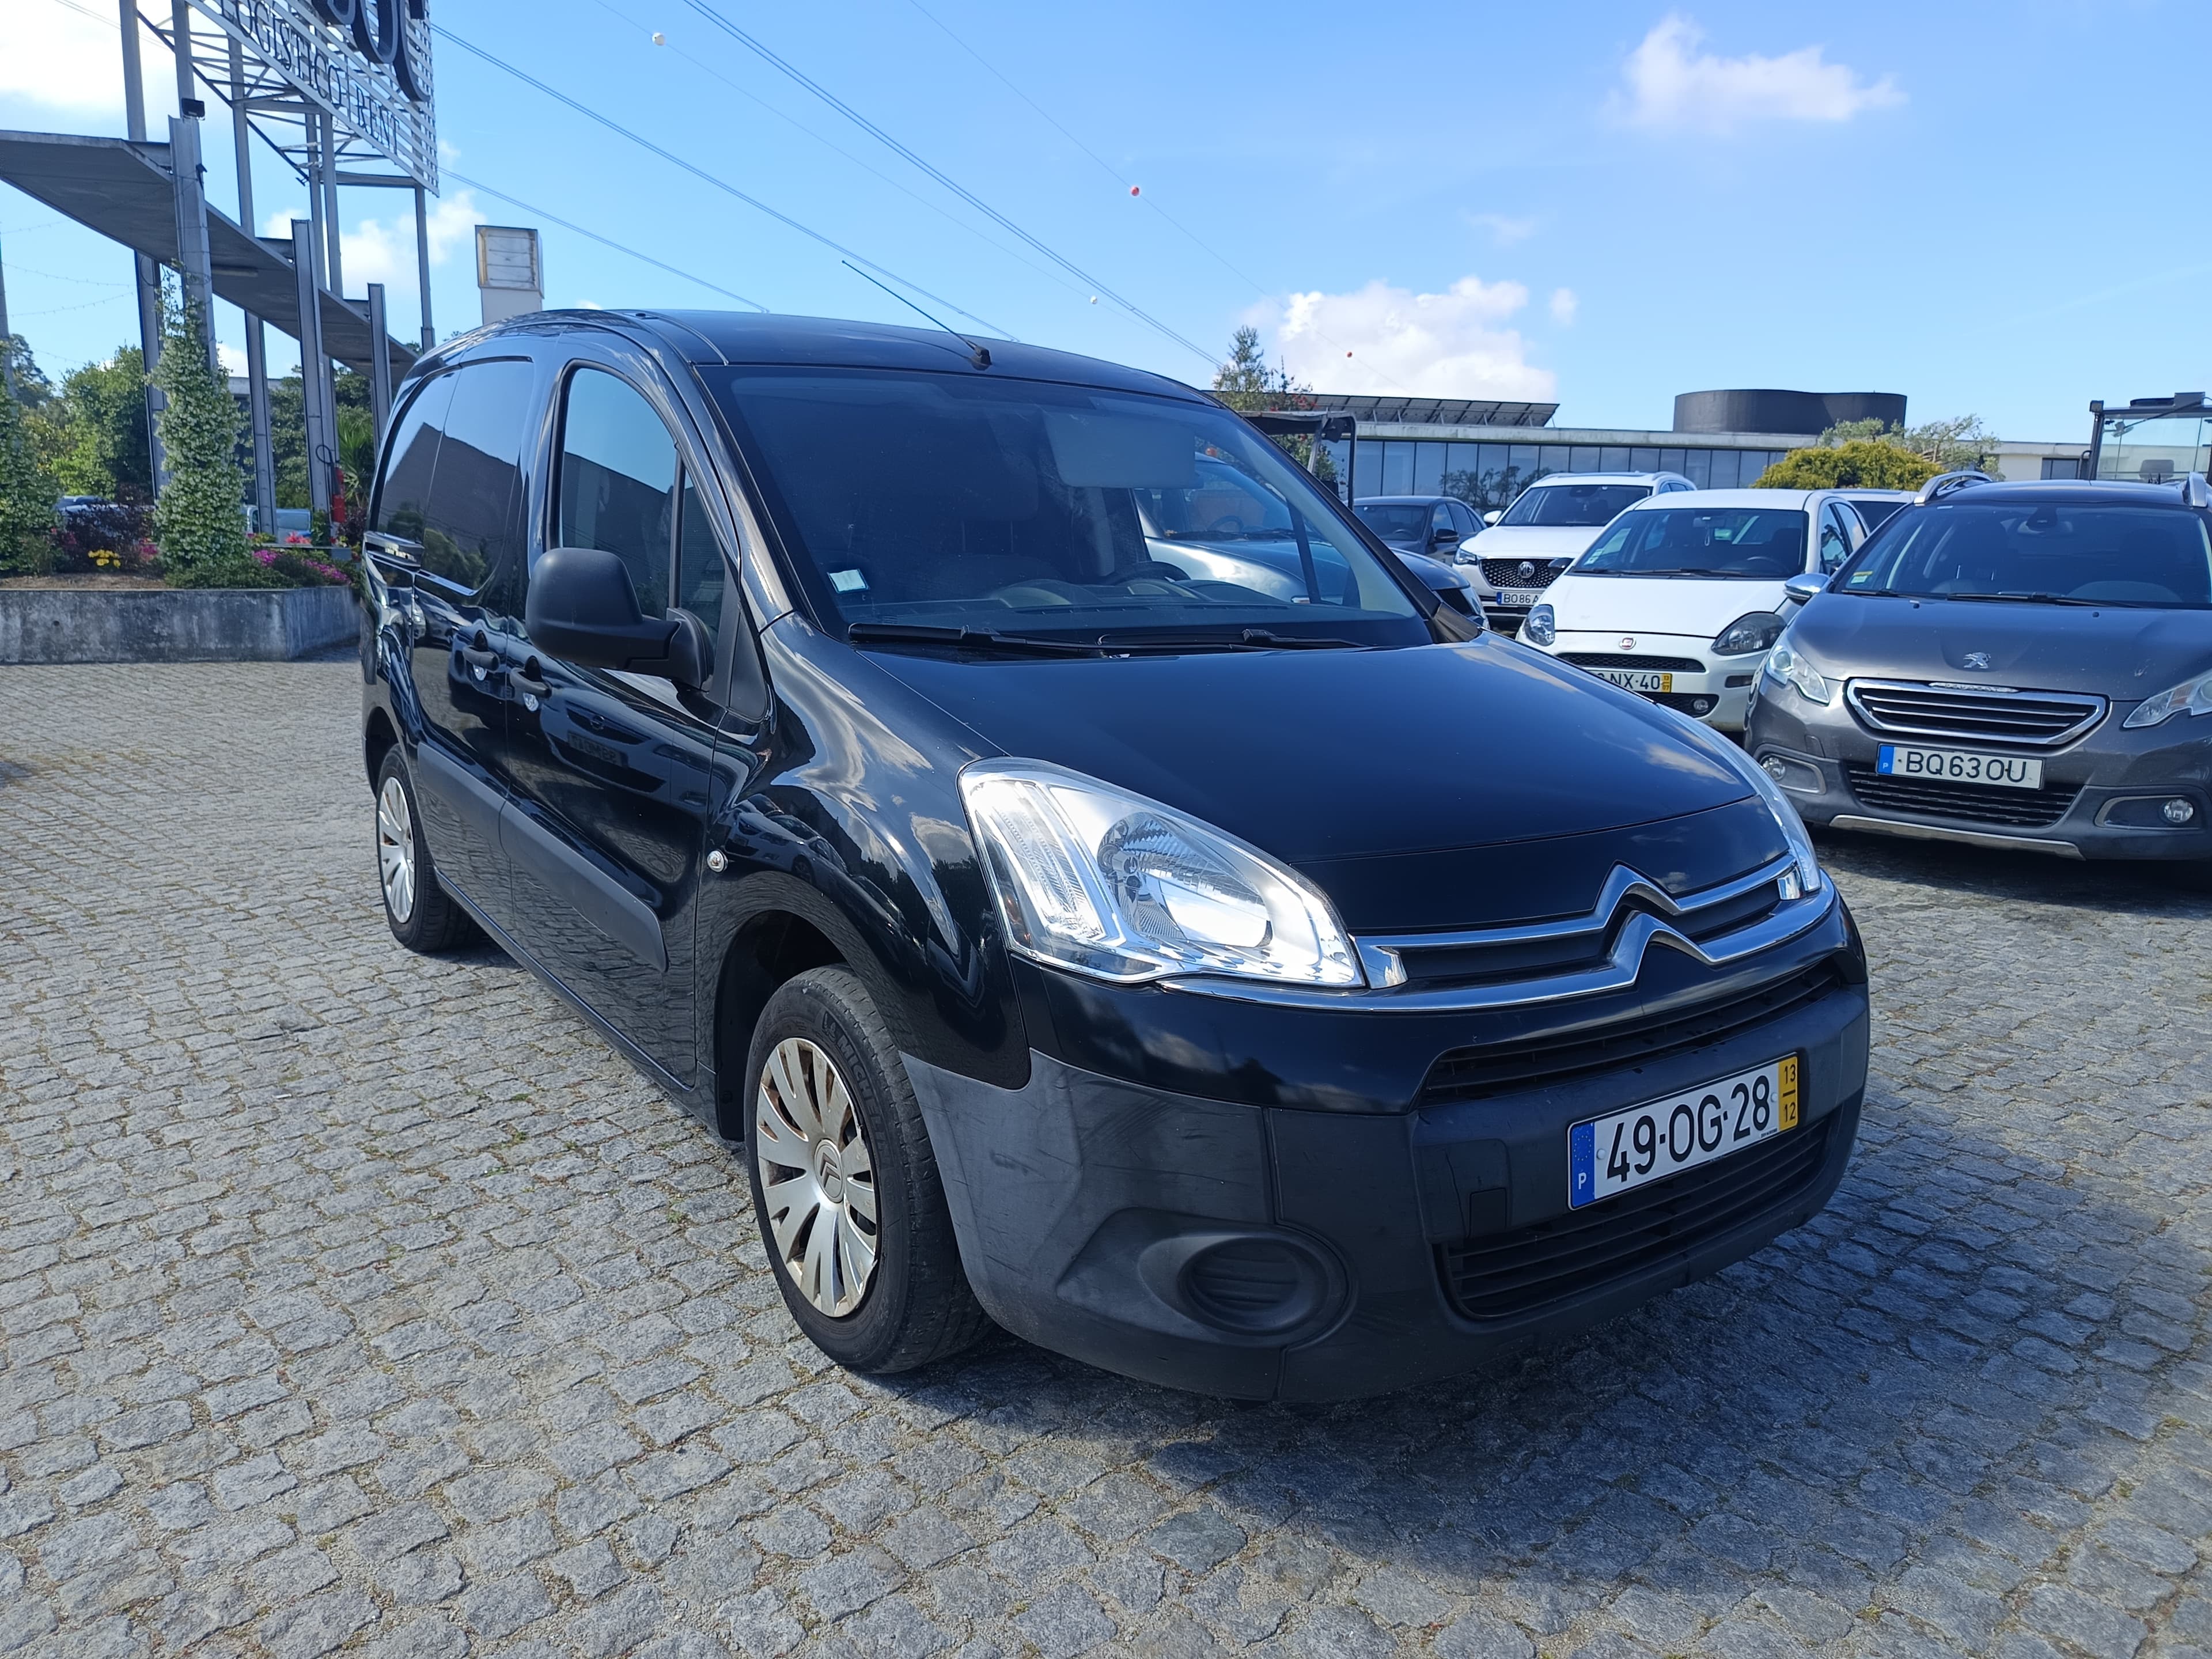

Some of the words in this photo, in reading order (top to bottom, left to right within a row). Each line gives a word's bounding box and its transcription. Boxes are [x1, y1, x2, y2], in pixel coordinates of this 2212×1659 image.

[355, 83, 400, 155] RENT
[1784, 1063, 1796, 1084] 13
[1784, 1102, 1796, 1123] 12
[1578, 1172, 1587, 1190] P
